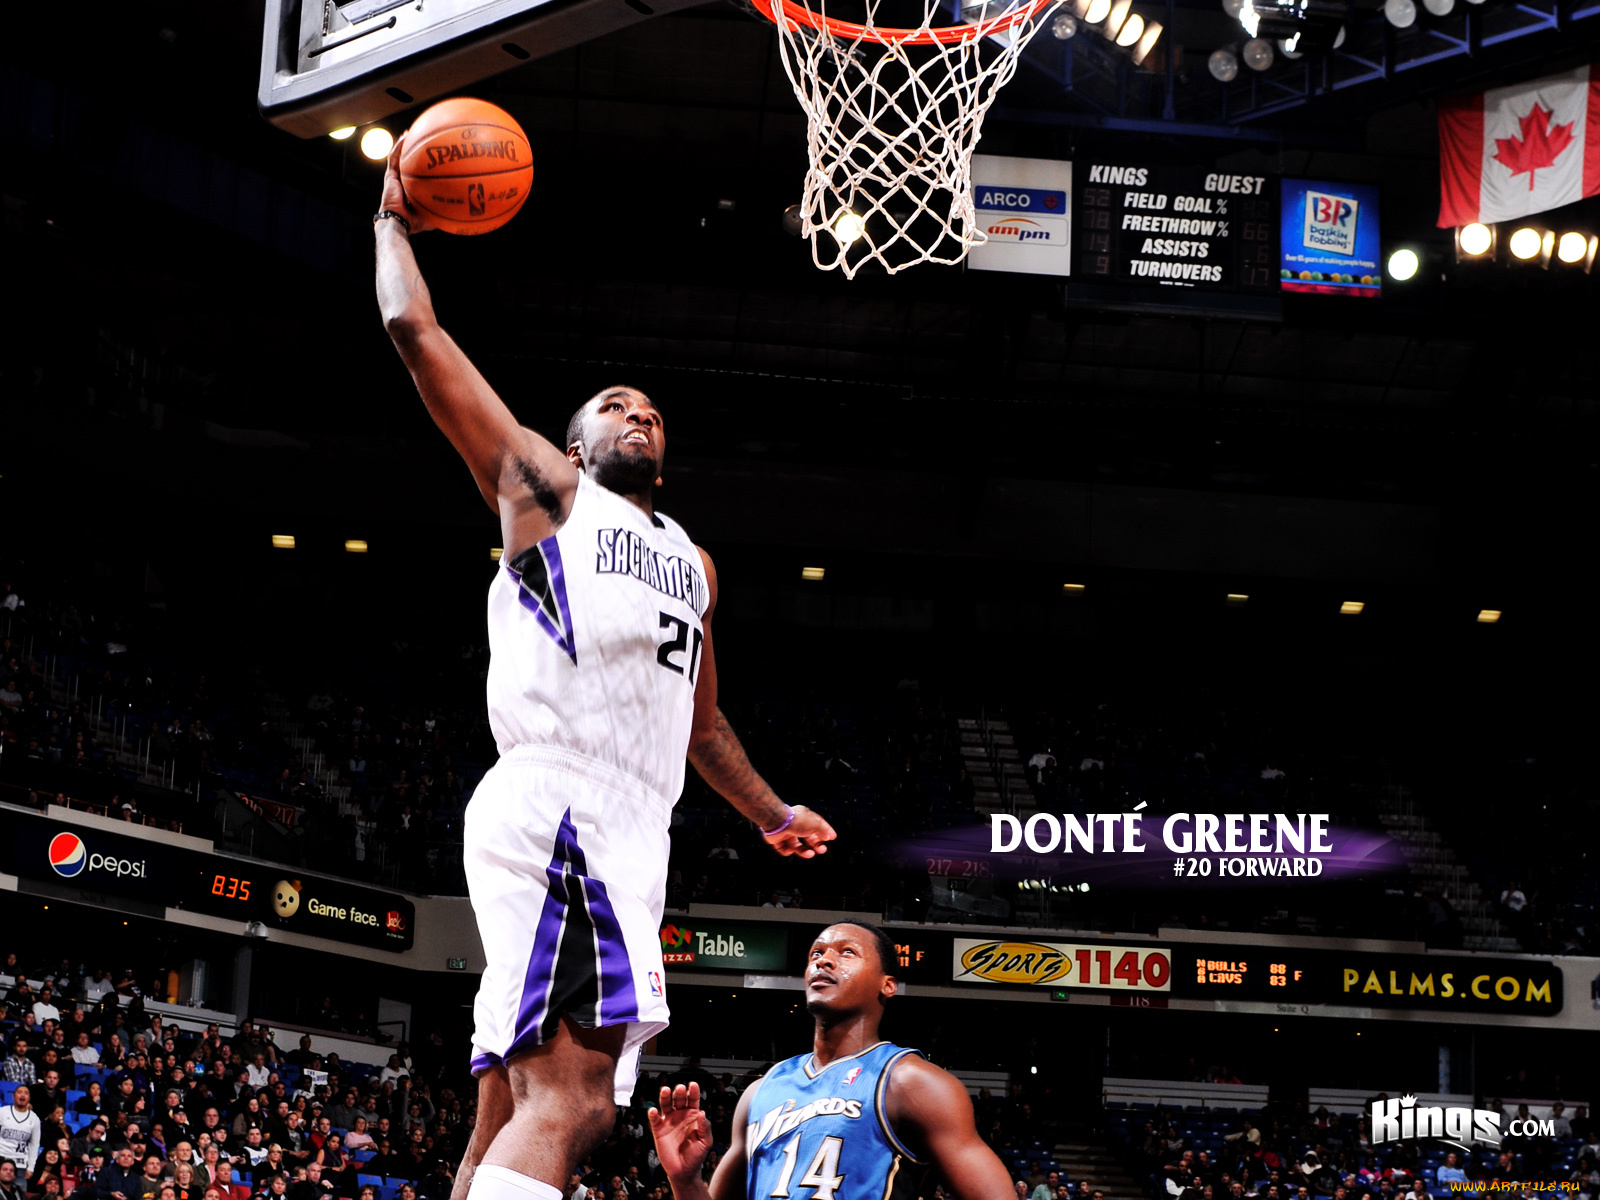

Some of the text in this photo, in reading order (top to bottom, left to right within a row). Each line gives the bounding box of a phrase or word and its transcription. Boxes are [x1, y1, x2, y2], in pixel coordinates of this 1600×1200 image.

[426, 140, 517, 170] SPALDING
[1089, 164, 1149, 187] KINGS
[1204, 173, 1266, 195] GUEST
[982, 192, 1031, 207] ARCO
[1123, 192, 1167, 210] FIELD
[1312, 197, 1352, 228] BR
[1141, 238, 1210, 258] ASSISTS
[1130, 260, 1223, 282] TURNOVERS
[89, 853, 145, 877] pepsi
[926, 858, 990, 878] 217 218
[308, 898, 380, 927] Game face.
[695, 931, 745, 957] Table
[663, 954, 693, 962] IZZA
[955, 943, 1171, 988] SPORTS 1140
[1207, 960, 1248, 972] BULLS
[1294, 971, 1303, 981] F
[1343, 968, 1552, 1003] PALMS.COM
[1277, 1003, 1297, 1013] Suite
[770, 1131, 845, 1200] 14
